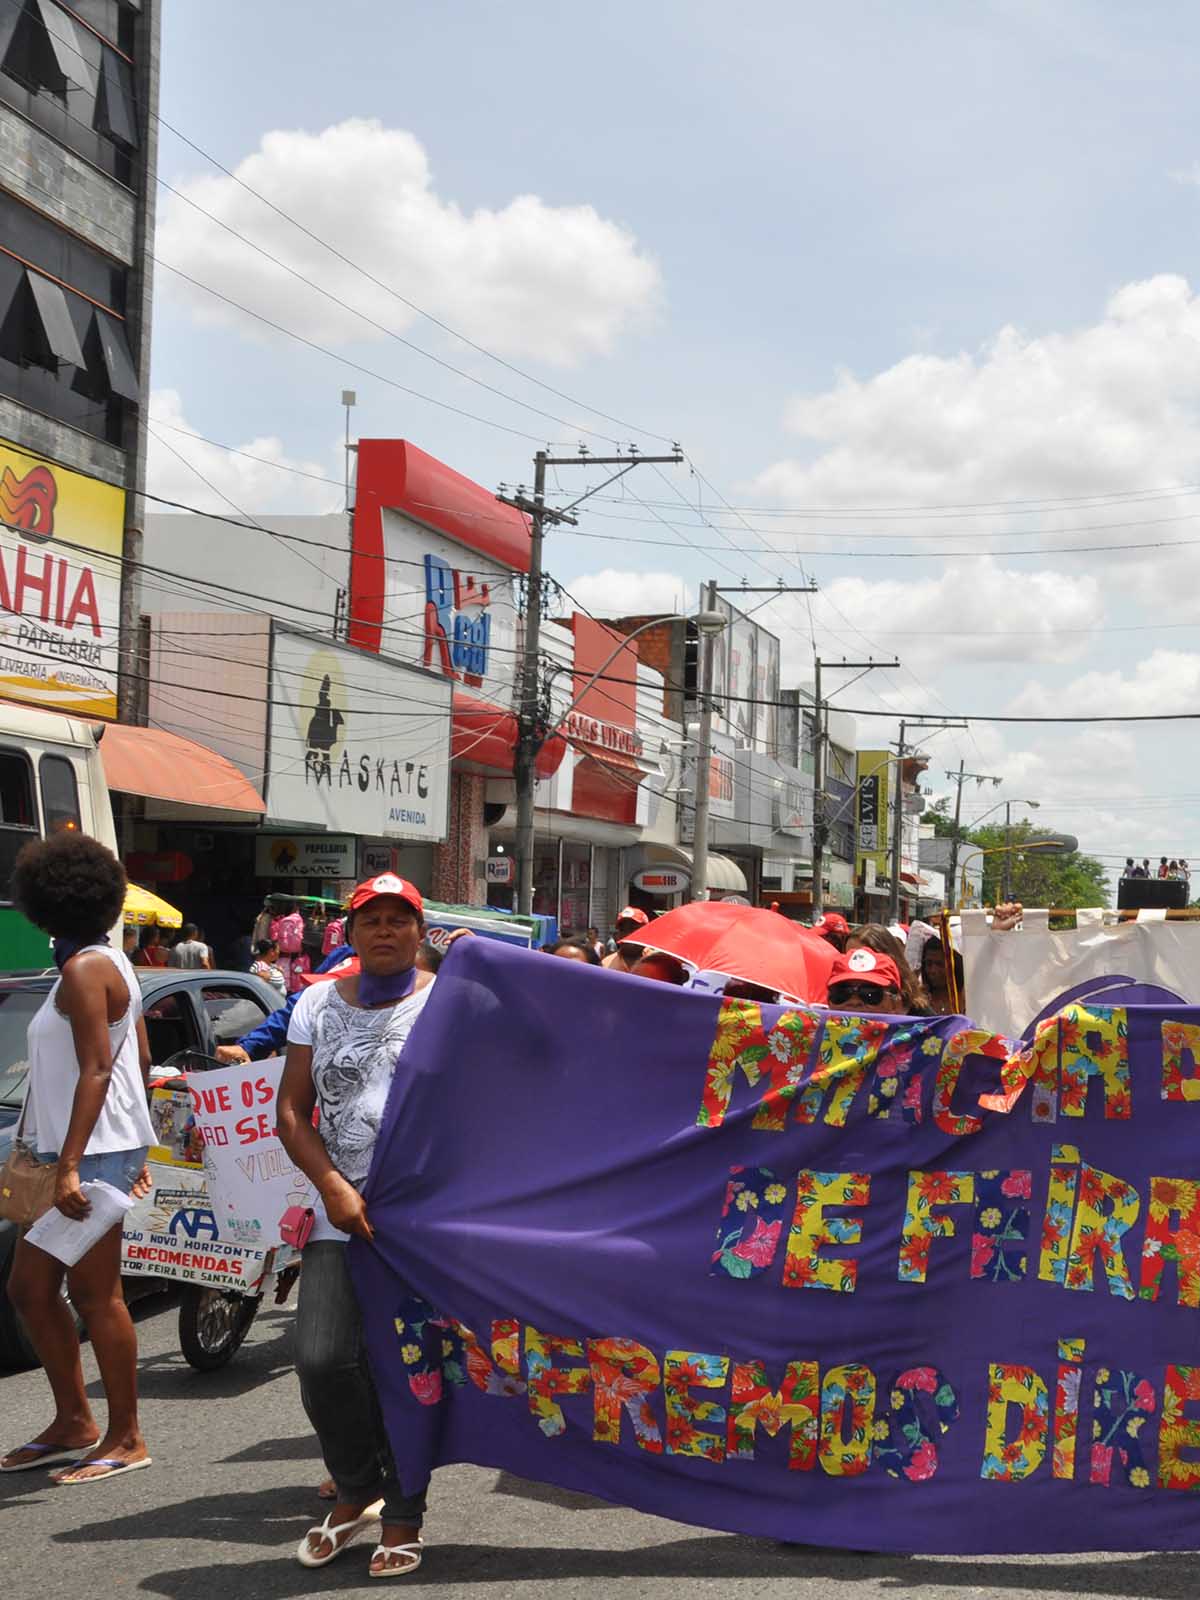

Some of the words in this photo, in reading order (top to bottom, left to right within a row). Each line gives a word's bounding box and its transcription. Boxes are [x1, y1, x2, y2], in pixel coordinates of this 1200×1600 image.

[17, 623, 103, 665] PAPELARIA
[304, 749, 429, 800] MASKATE
[388, 807, 427, 826] AVENIDA
[241, 1077, 275, 1109] OS
[235, 1113, 280, 1146] SE
[710, 1164, 873, 1294] DE
[127, 1244, 244, 1276] ENCOMENDAS
[150, 1233, 178, 1248] NOVO
[184, 1239, 264, 1261] HORIZONTE
[147, 1263, 178, 1277] FEIRA
[182, 1268, 197, 1280] DE
[200, 1272, 248, 1289] SANTANA
